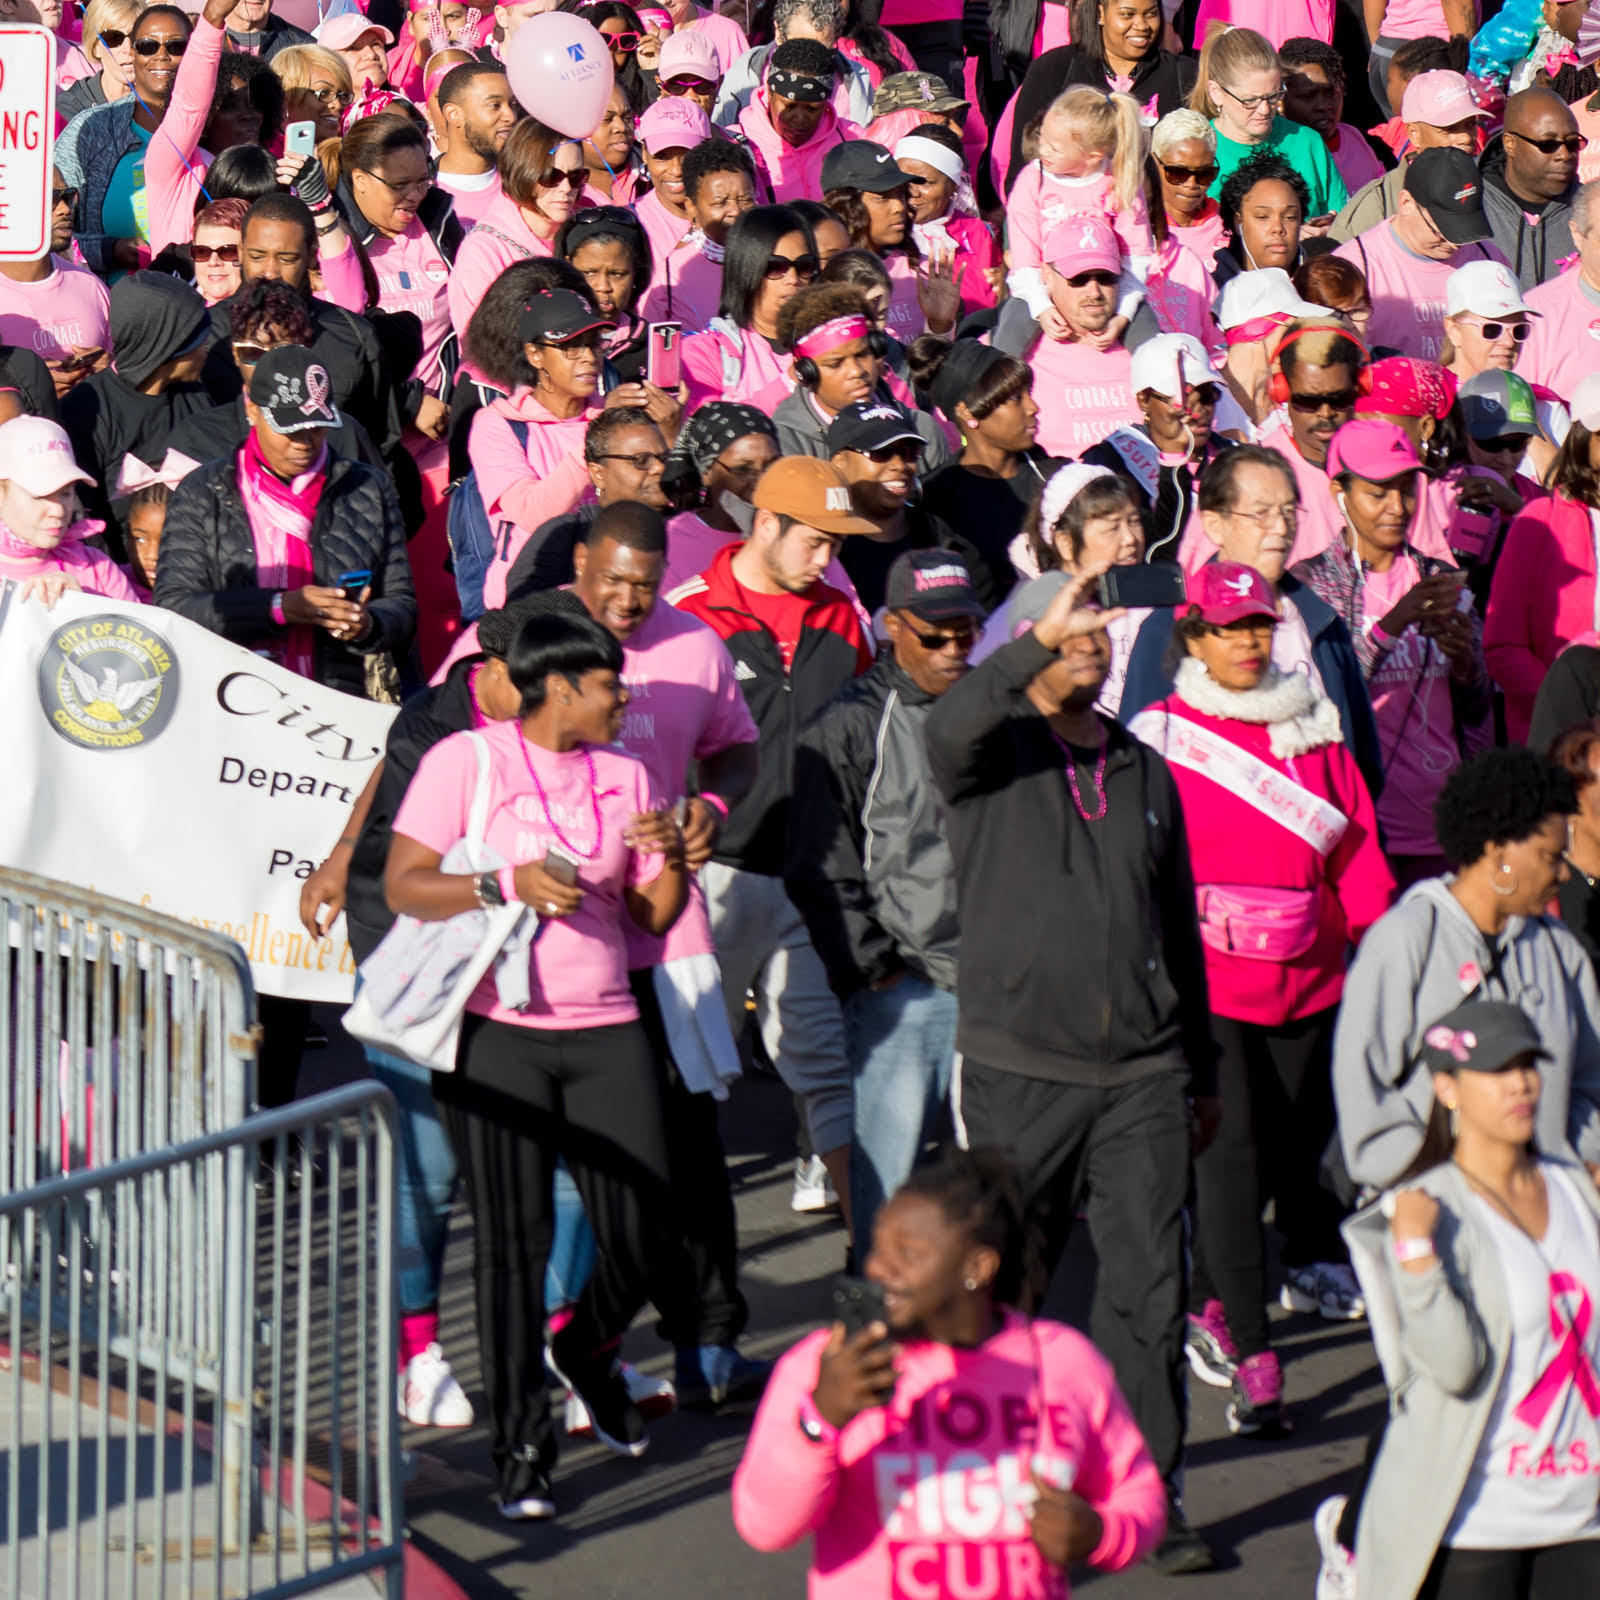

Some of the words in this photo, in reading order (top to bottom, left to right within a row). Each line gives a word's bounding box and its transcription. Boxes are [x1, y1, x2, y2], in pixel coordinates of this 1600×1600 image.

[33, 323, 83, 350] COURAGE
[1064, 385, 1127, 409] COURAGE
[57, 626, 87, 650] CITY
[92, 622, 113, 637] OF
[115, 623, 171, 672] ATLANTA
[54, 710, 144, 746] CORRECTIONS
[216, 672, 379, 761] City
[219, 757, 353, 804] Depart
[896, 1542, 1047, 1600] CUR
